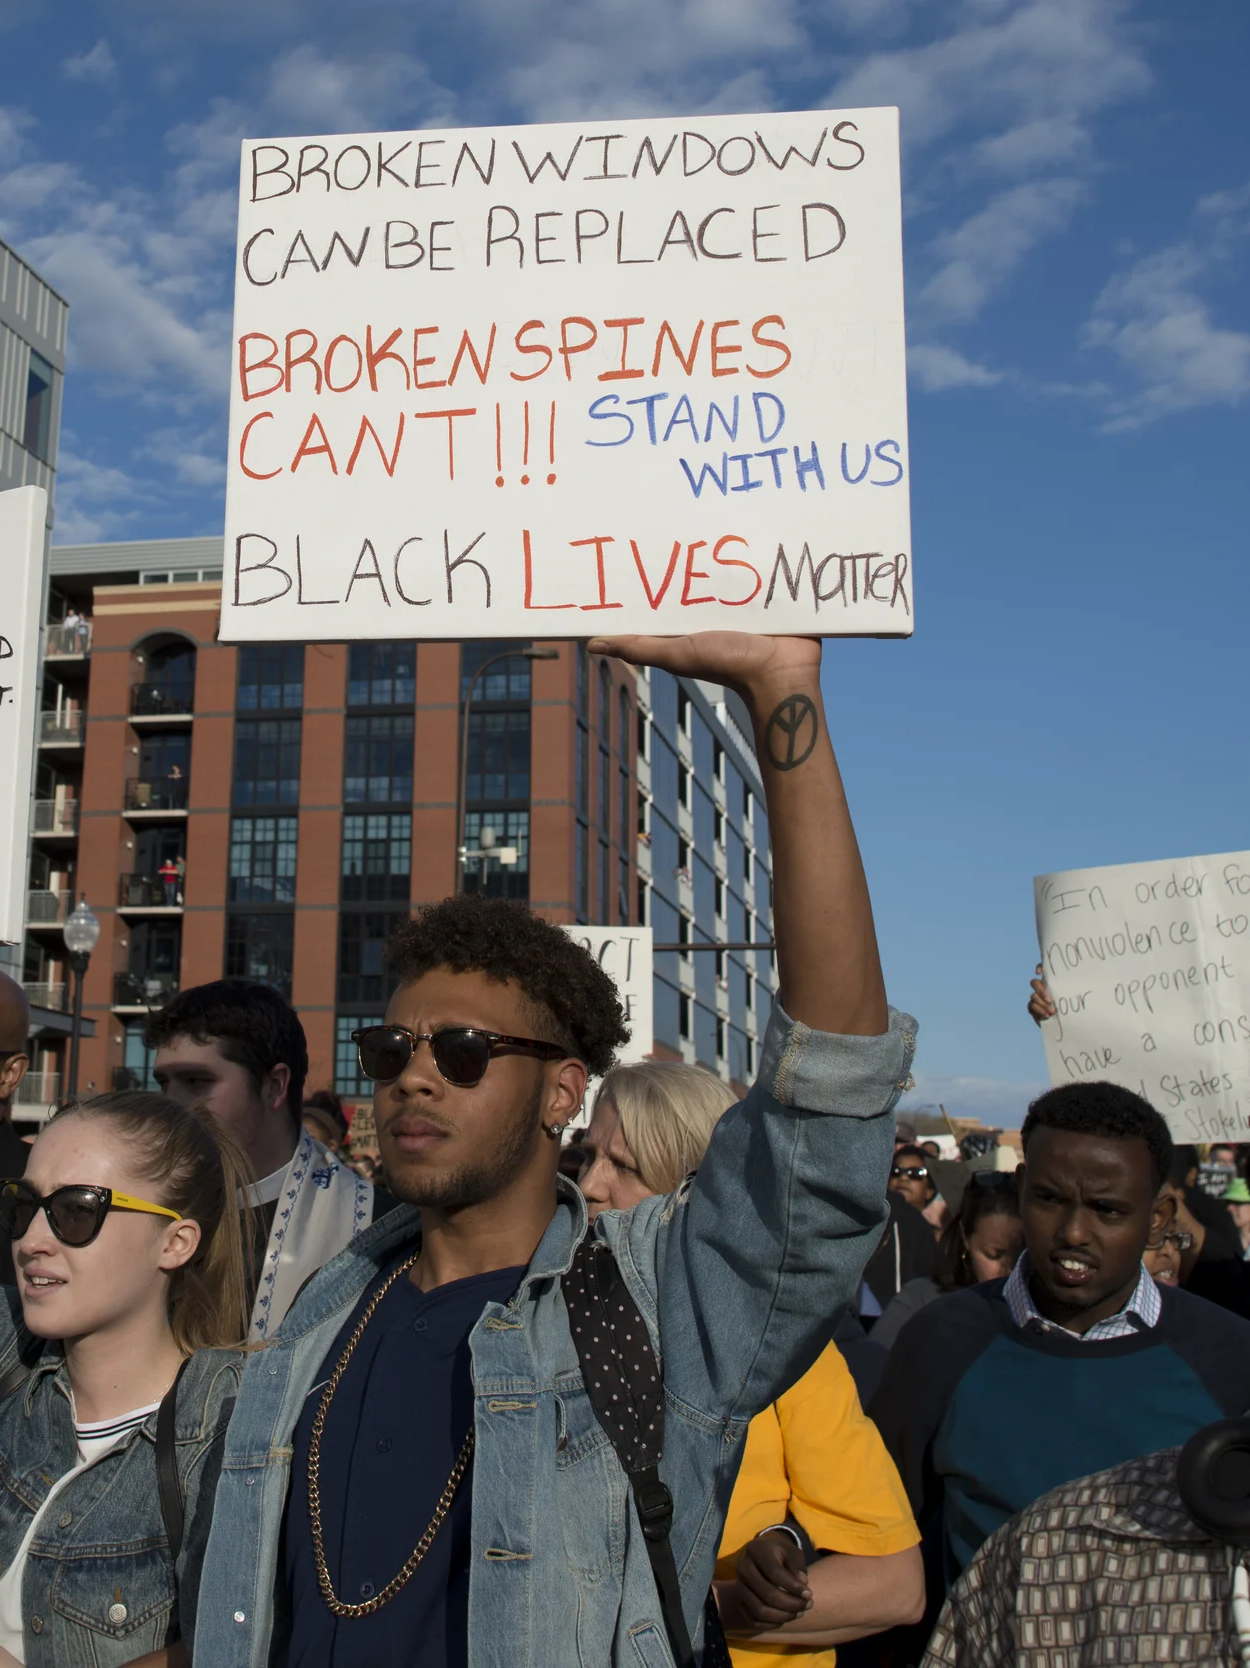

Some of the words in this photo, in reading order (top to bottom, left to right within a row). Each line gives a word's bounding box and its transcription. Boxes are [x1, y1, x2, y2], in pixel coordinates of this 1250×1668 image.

[251, 138, 496, 202] BROKEN
[511, 121, 866, 183] WINDOWS
[242, 226, 370, 287] CAN
[384, 220, 455, 271] BE
[485, 203, 847, 267] REPLACED
[238, 322, 497, 401] BROKEN
[510, 315, 792, 381] SPINES
[239, 401, 558, 488] CANT!!!
[586, 392, 785, 446] STAND
[679, 443, 825, 498] WITH
[841, 439, 903, 487] US
[231, 529, 492, 608] BLACK
[523, 529, 762, 611] LIVES
[1135, 872, 1208, 903] order
[1046, 920, 1196, 977] nonviolence
[1216, 914, 1249, 938] to
[1114, 955, 1235, 1014] opponent
[1059, 1046, 1122, 1078] have
[1141, 1032, 1157, 1052] a
[1160, 1069, 1233, 1108] States
